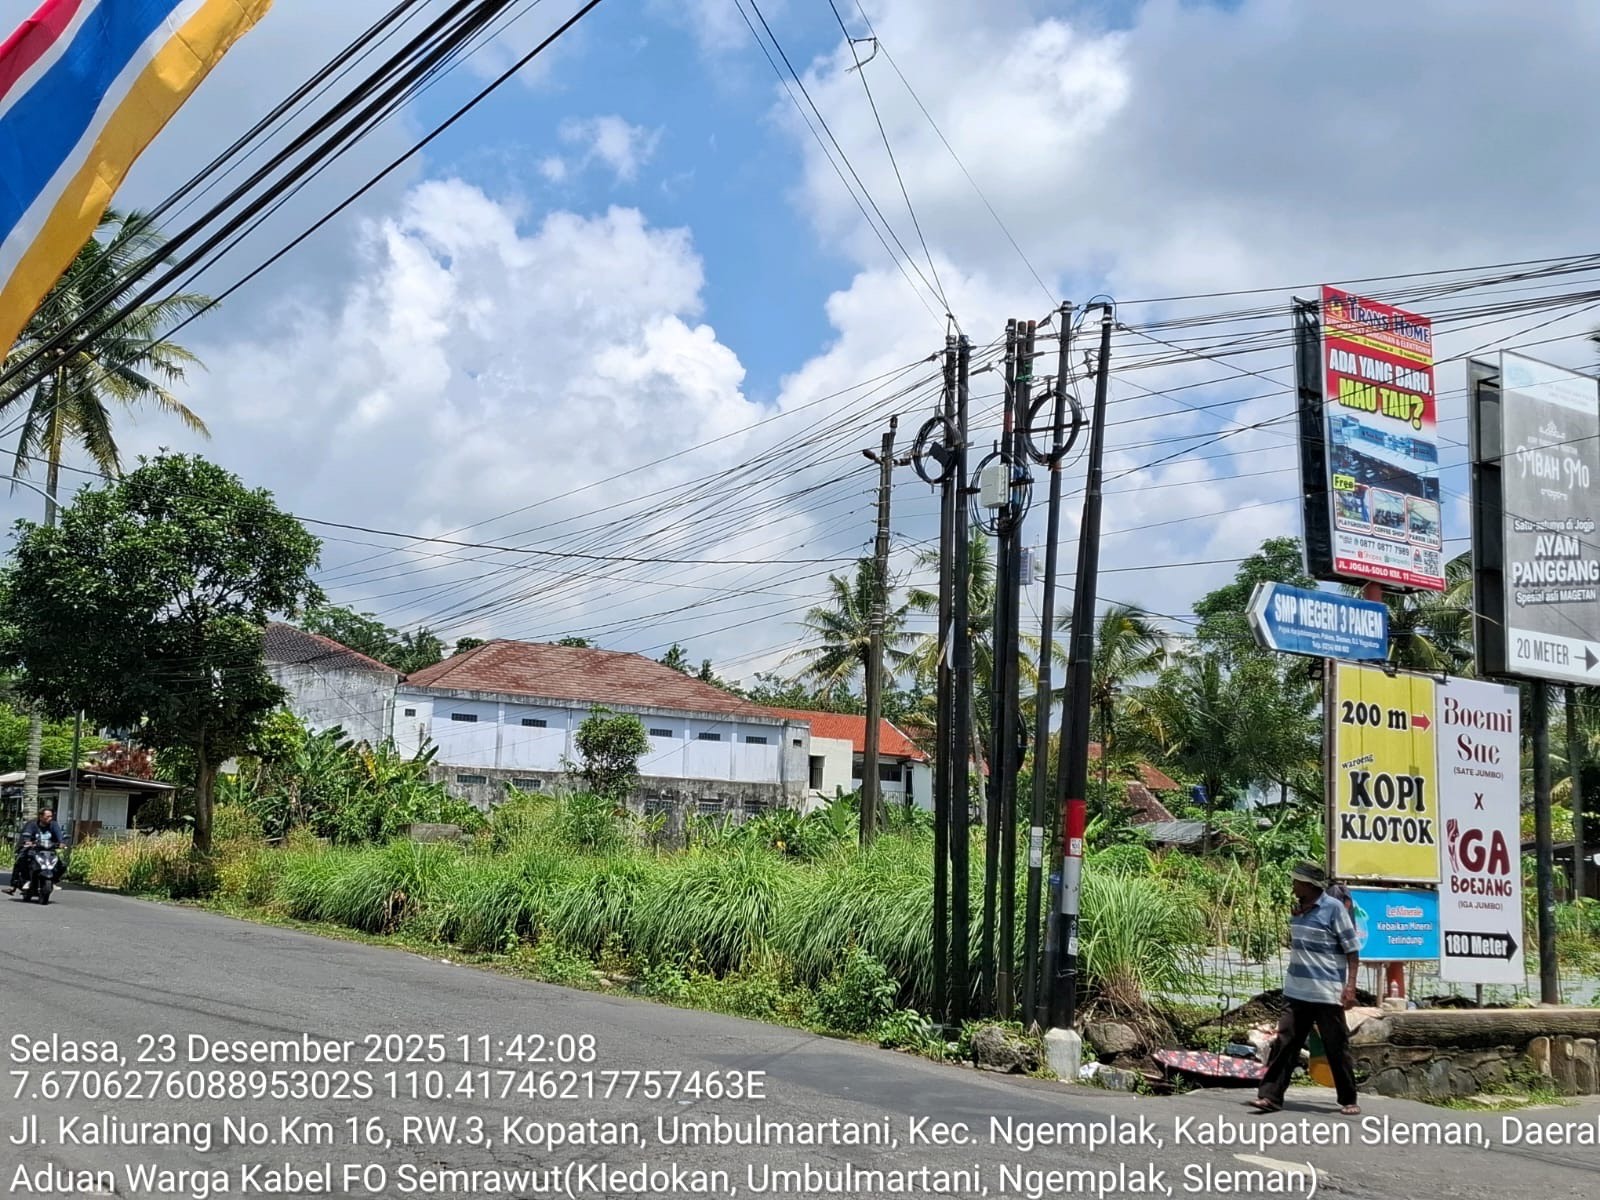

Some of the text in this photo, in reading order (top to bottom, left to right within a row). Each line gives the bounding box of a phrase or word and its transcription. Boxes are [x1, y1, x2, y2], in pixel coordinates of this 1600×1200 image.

[1329, 348, 1357, 375] ADA
[1359, 355, 1393, 385] YANG
[1395, 365, 1433, 396] BARU,
[1339, 377, 1424, 430] MAU TAU?
[1516, 445, 1560, 481] MBAH
[1563, 457, 1590, 489] MO
[1334, 475, 1354, 489] Free
[1566, 519, 1574, 530] di
[1574, 519, 1595, 533] Jogja
[1534, 534, 1580, 557] AYAM
[1349, 561, 1388, 577] JOGJA-SOLO
[1511, 559, 1600, 585] PANGGANG
[1516, 588, 1596, 604] Spesial asli MAGETAN
[1274, 593, 1297, 624] SMP
[1299, 598, 1338, 631] NEGERI
[1340, 604, 1347, 633] 3
[1348, 606, 1383, 640] PAKEM
[1516, 638, 1569, 666] 20 METER
[1341, 700, 1407, 730] 200 m
[1444, 697, 1512, 733] Boemi
[1341, 754, 1374, 770] waroeng
[1453, 766, 1504, 781] (SATE JUMBO)
[1349, 771, 1426, 812] KOPI
[1340, 813, 1434, 844] KLOTOK
[1451, 875, 1512, 897] BOEJANG
[1458, 900, 1504, 911] (IGA JUMBO)
[1377, 921, 1408, 931] Kebaikan
[1446, 935, 1509, 956] 180 Meter
